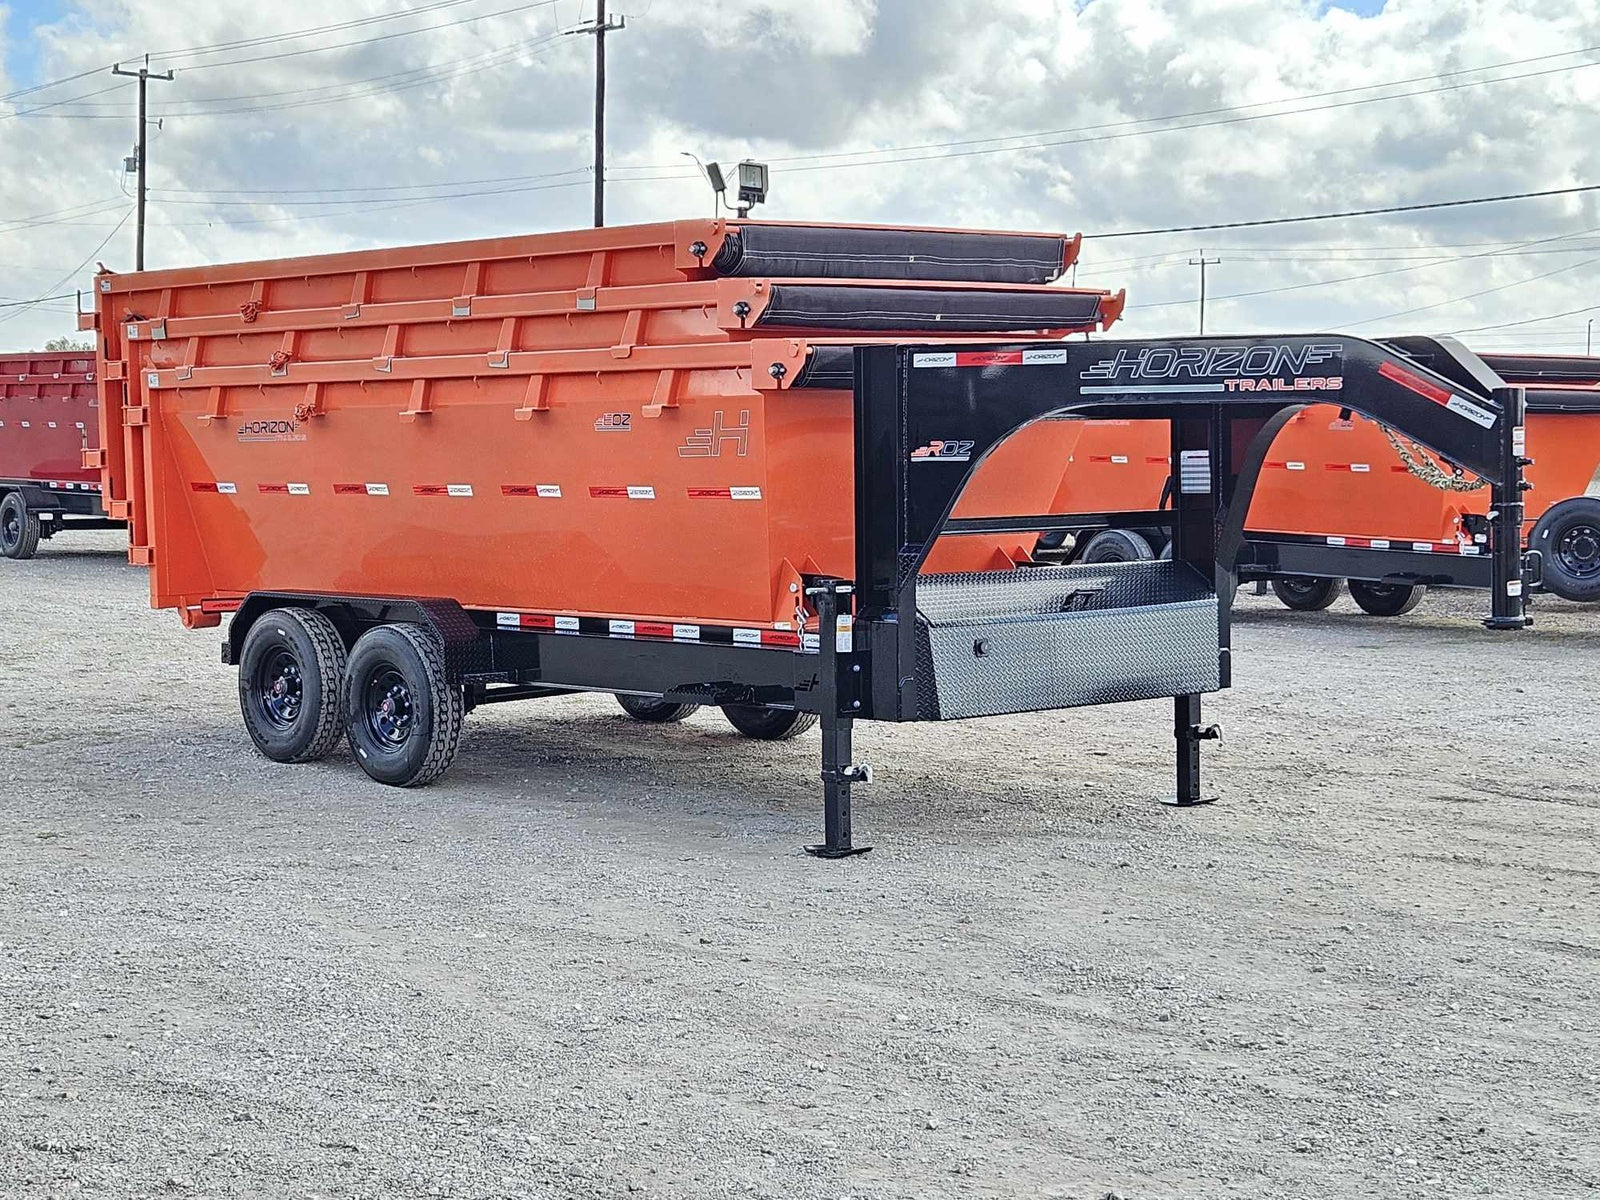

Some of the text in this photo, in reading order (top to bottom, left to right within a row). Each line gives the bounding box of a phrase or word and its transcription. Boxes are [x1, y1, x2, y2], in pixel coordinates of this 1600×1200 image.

[1108, 345, 1311, 379] HORIZON
[1223, 376, 1344, 392] TRAILERS
[243, 420, 296, 434] HORIZON
